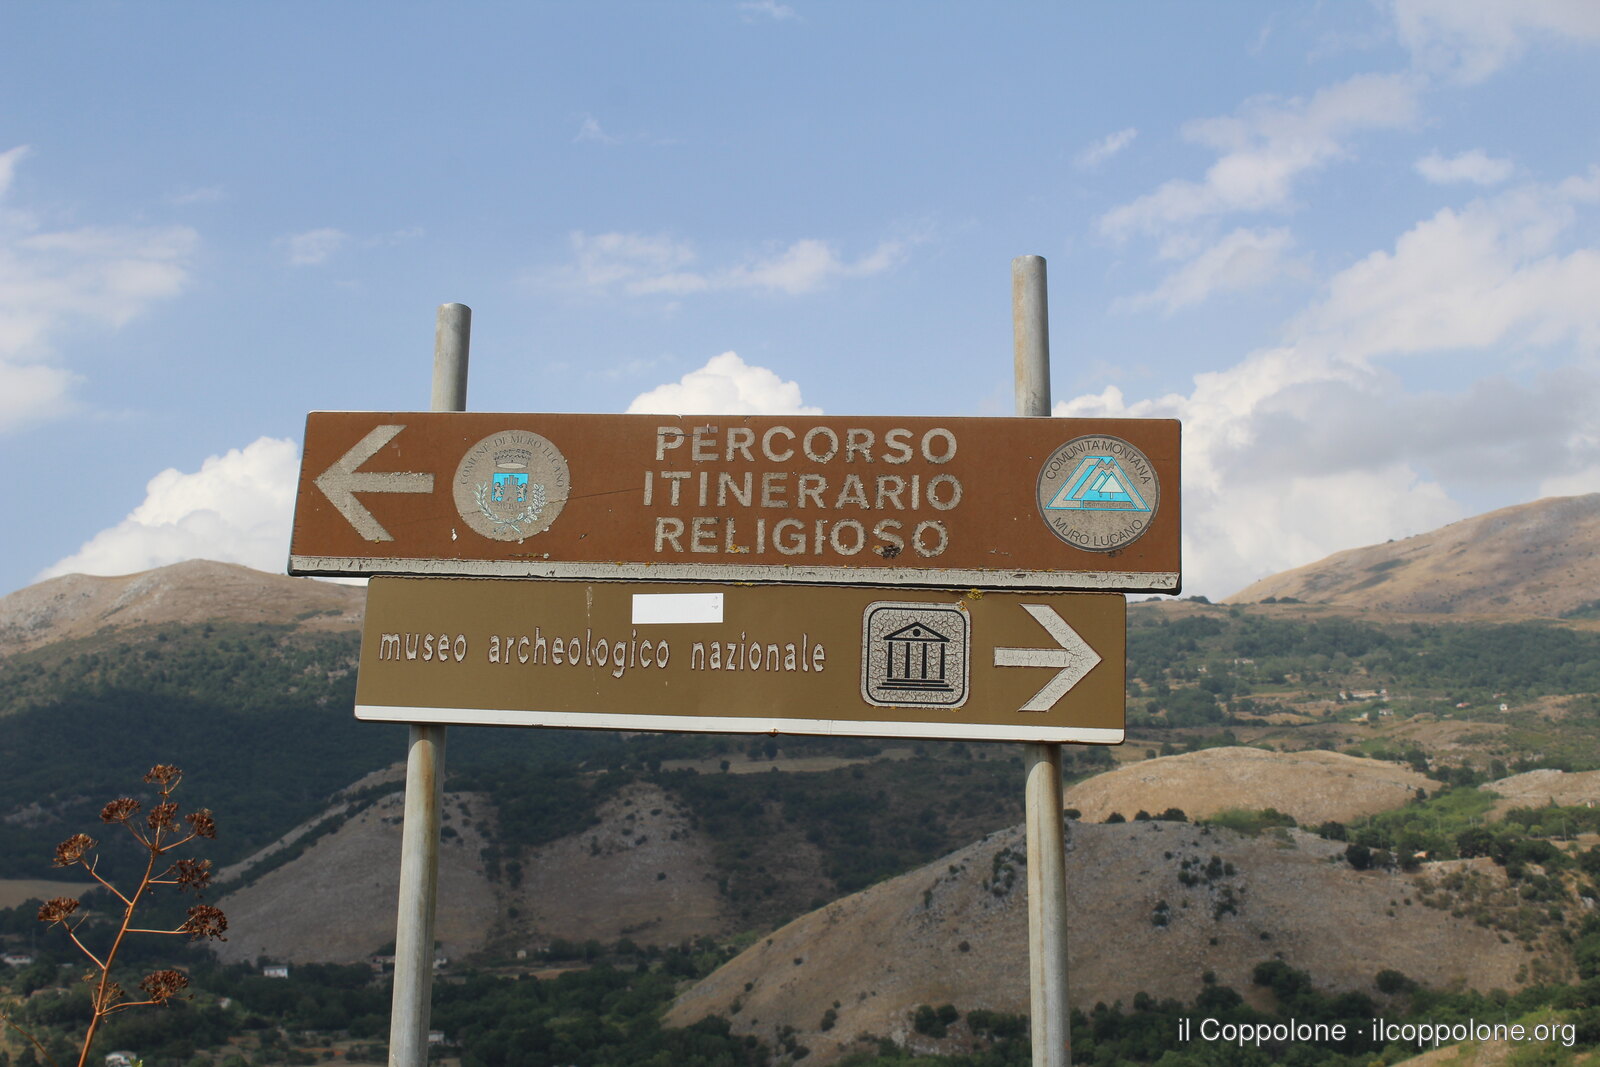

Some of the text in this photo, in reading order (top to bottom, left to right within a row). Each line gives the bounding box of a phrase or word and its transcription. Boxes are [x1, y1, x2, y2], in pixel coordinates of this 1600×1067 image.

[494, 436, 506, 447] DI
[510, 435, 542, 449] MURO
[656, 426, 957, 464] PERCORSO
[1101, 440, 1152, 485] MONTANA
[643, 471, 963, 511] ITINERARIO
[654, 517, 949, 558] RELIGIOSO
[1053, 517, 1143, 547] MURO LUCANO
[379, 627, 826, 679] museo archeologico nazionale
